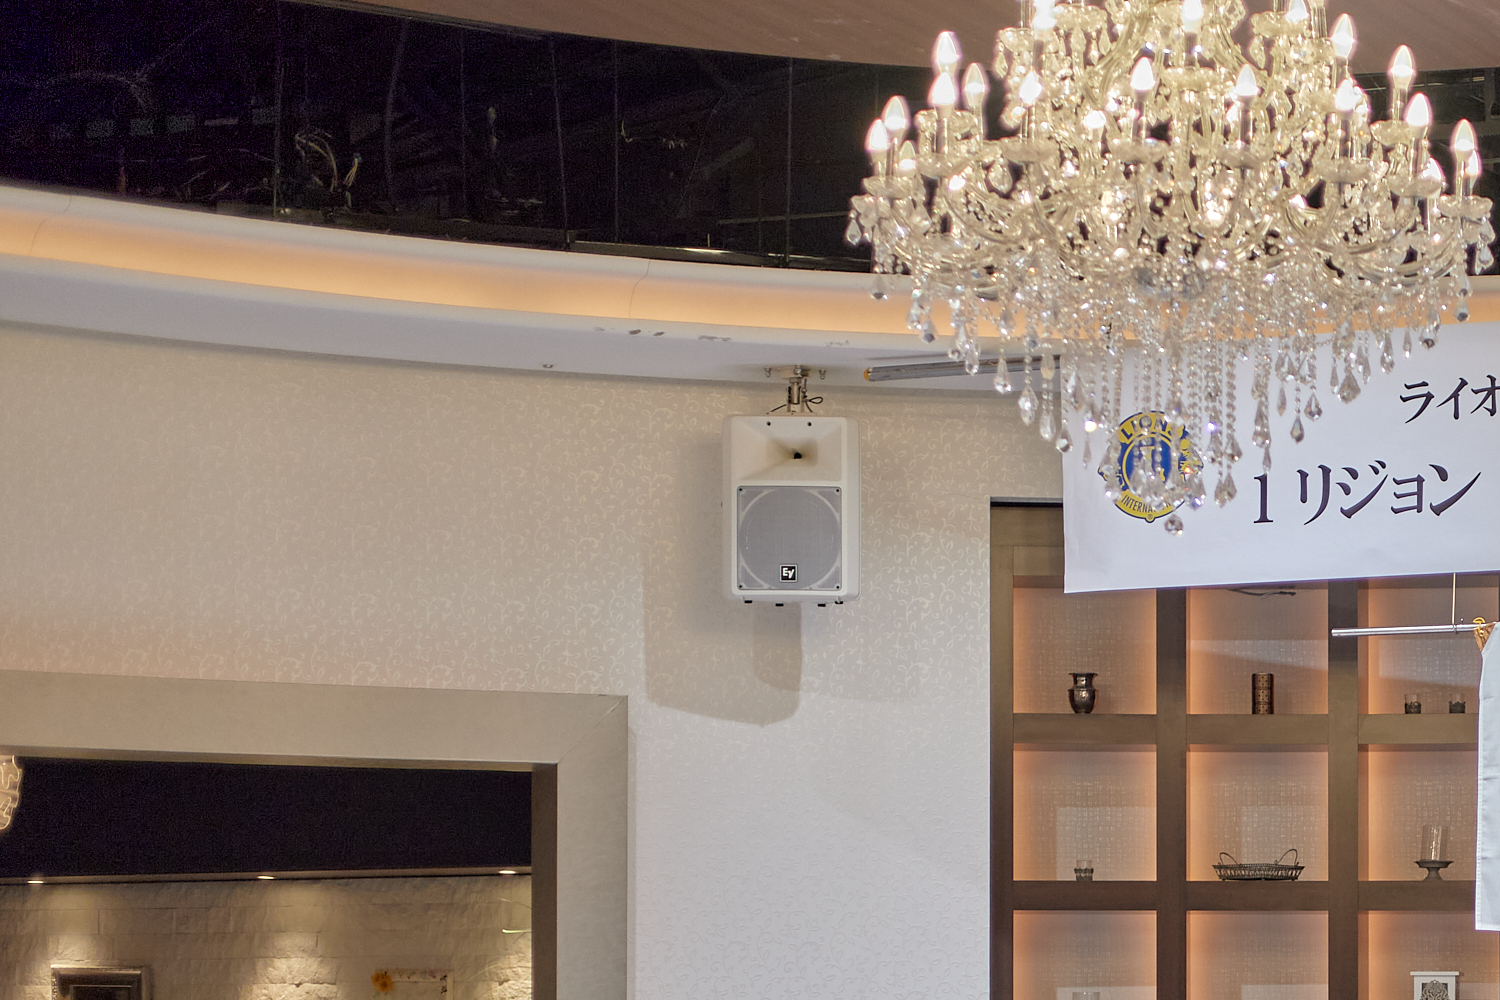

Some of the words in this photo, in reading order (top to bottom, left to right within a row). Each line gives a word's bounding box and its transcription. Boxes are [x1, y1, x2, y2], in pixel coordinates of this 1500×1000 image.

[1253, 474, 1274, 524] 1
[1296, 460, 1482, 526] リジョン
